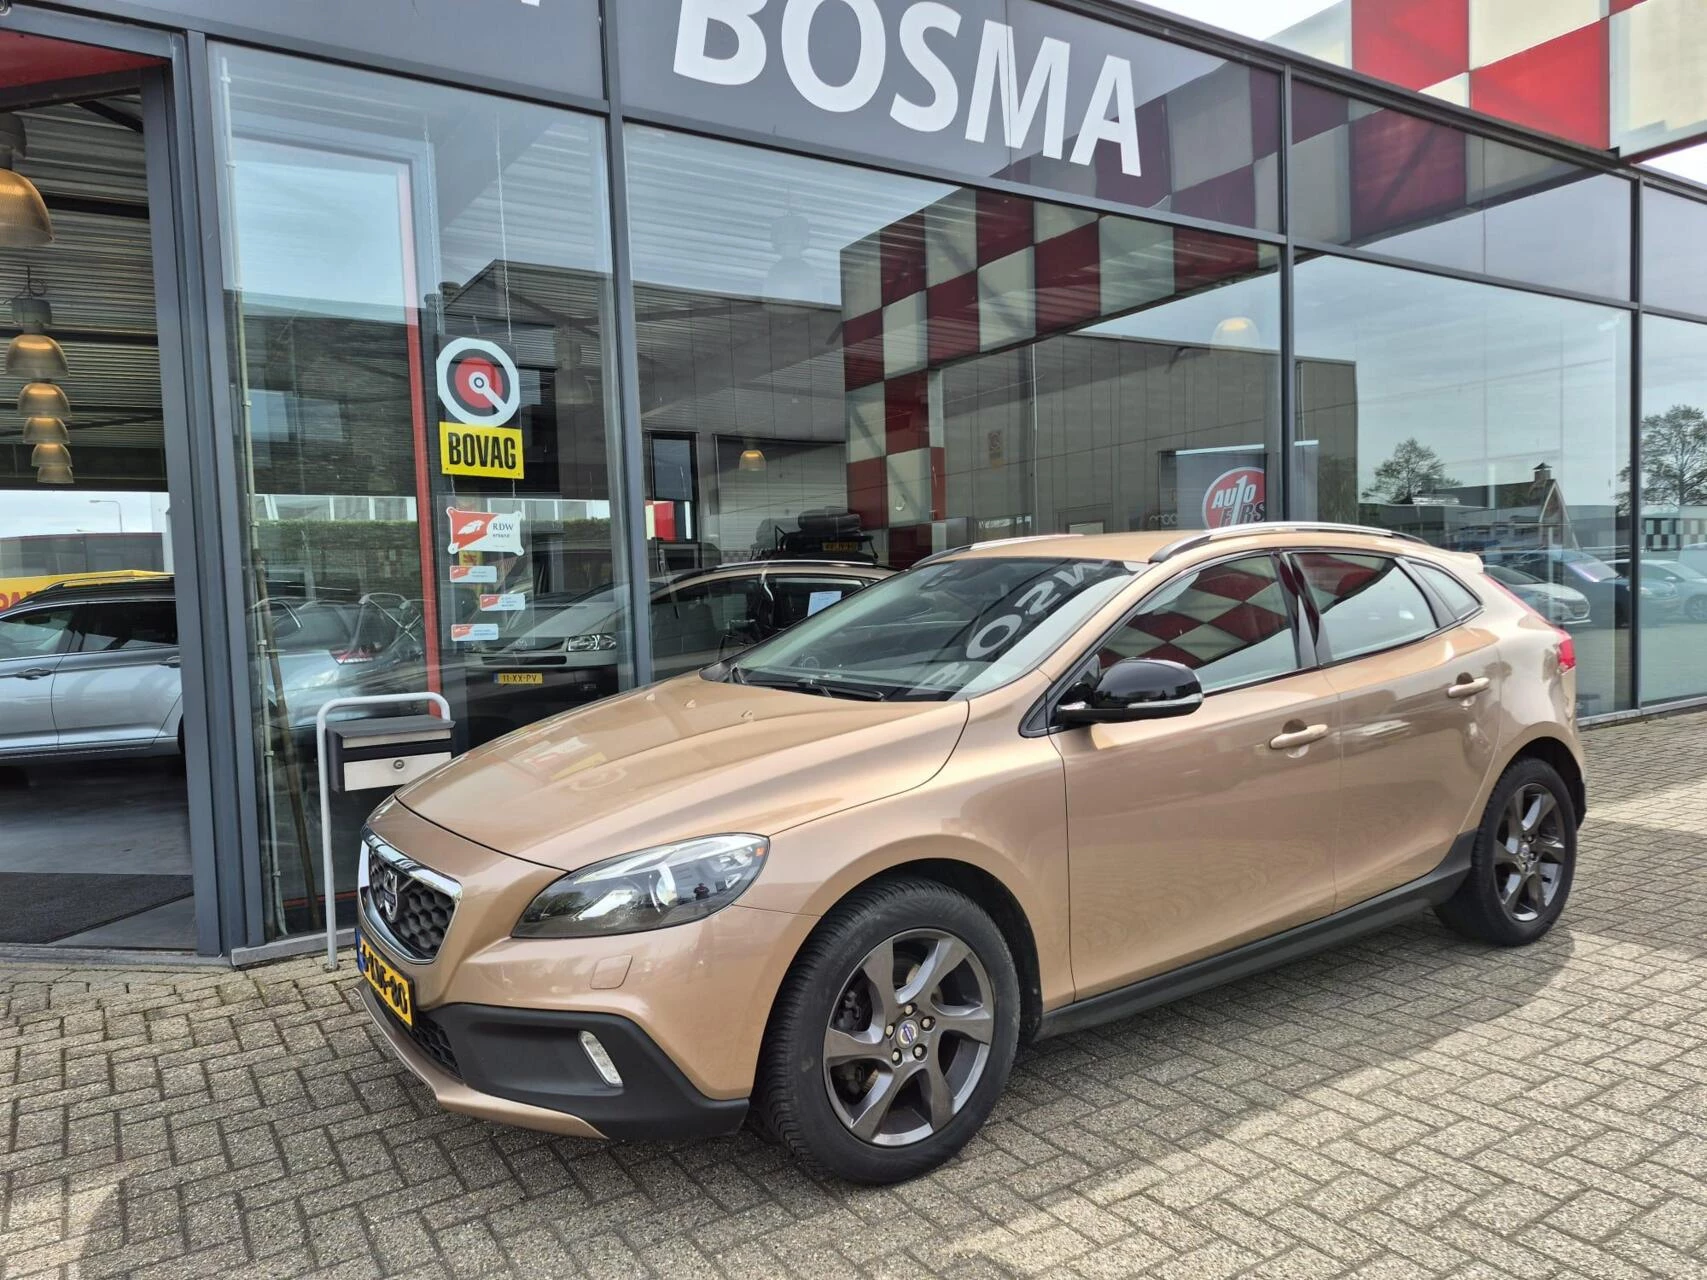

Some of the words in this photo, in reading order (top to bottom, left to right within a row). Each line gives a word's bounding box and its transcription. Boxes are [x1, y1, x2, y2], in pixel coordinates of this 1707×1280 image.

[673, 0, 1141, 177] BOSMA
[448, 432, 516, 470] BOVAG
[492, 523, 514, 531] RDW
